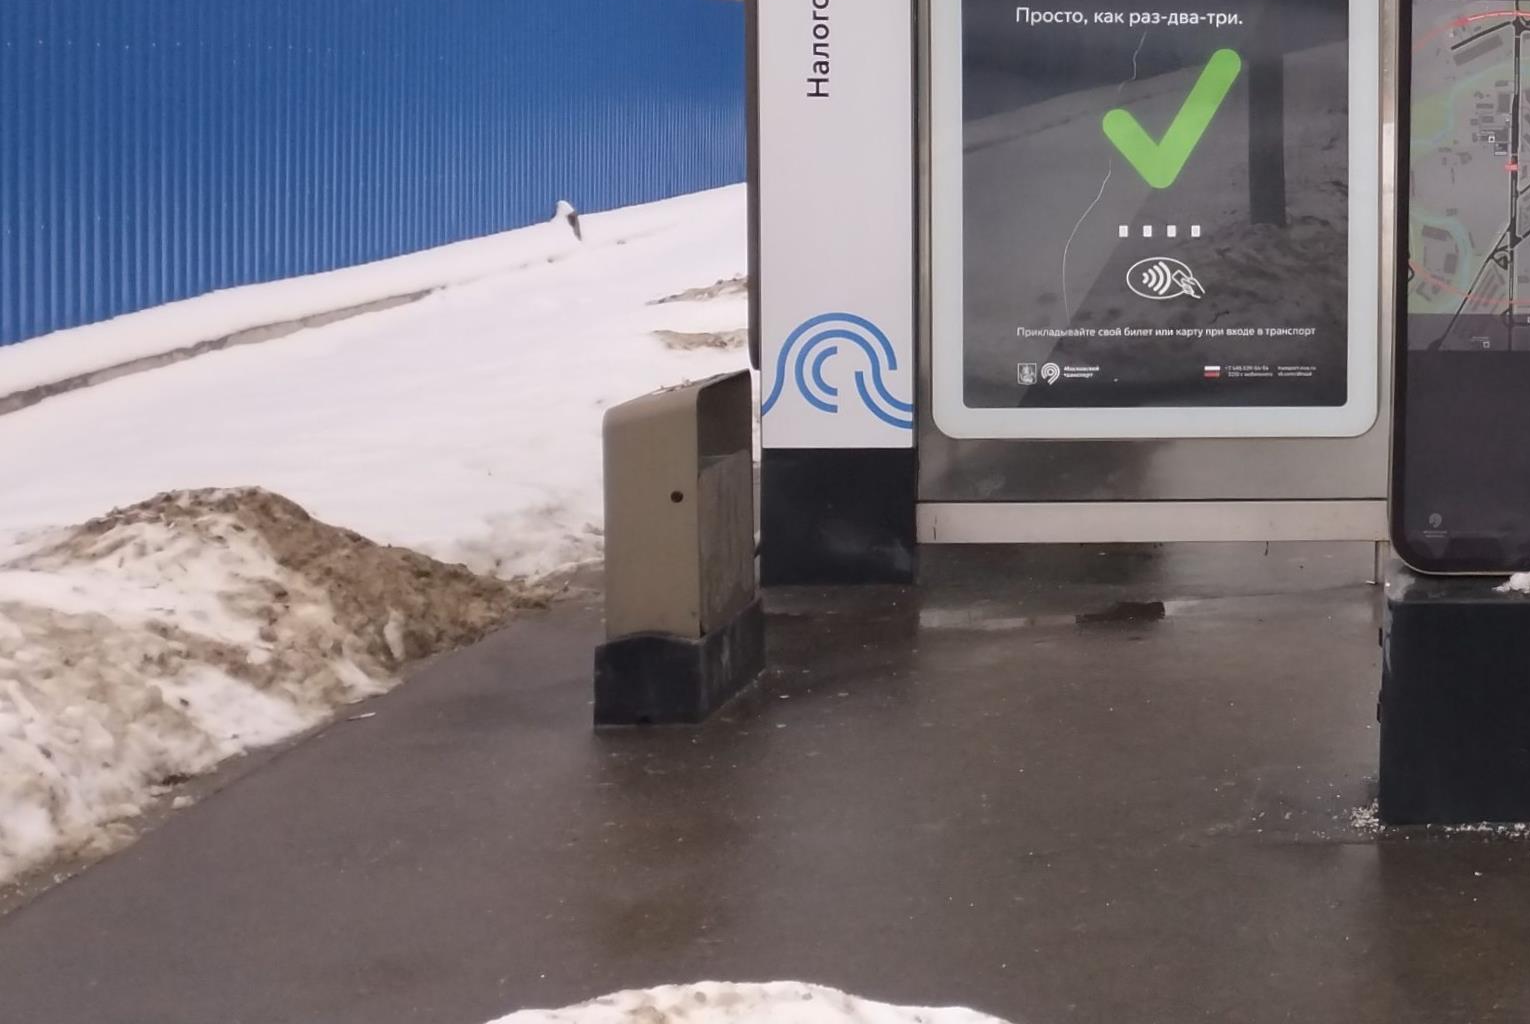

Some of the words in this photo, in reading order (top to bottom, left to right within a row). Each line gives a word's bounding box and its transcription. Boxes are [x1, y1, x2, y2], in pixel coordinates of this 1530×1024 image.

[1015, 7, 1089, 25] Просто,
[1093, 10, 1124, 24] как
[1128, 10, 1244, 27] раз-два-три.
[1016, 327, 1096, 337] Прикладывайте
[1097, 327, 1122, 337] свой
[1124, 327, 1153, 337] билет
[1155, 328, 1174, 337] или
[1175, 328, 1204, 338] карту
[1205, 328, 1225, 338] при
[1226, 327, 1256, 338] входе
[1256, 328, 1264, 337] в
[1265, 327, 1317, 338] транспорт
